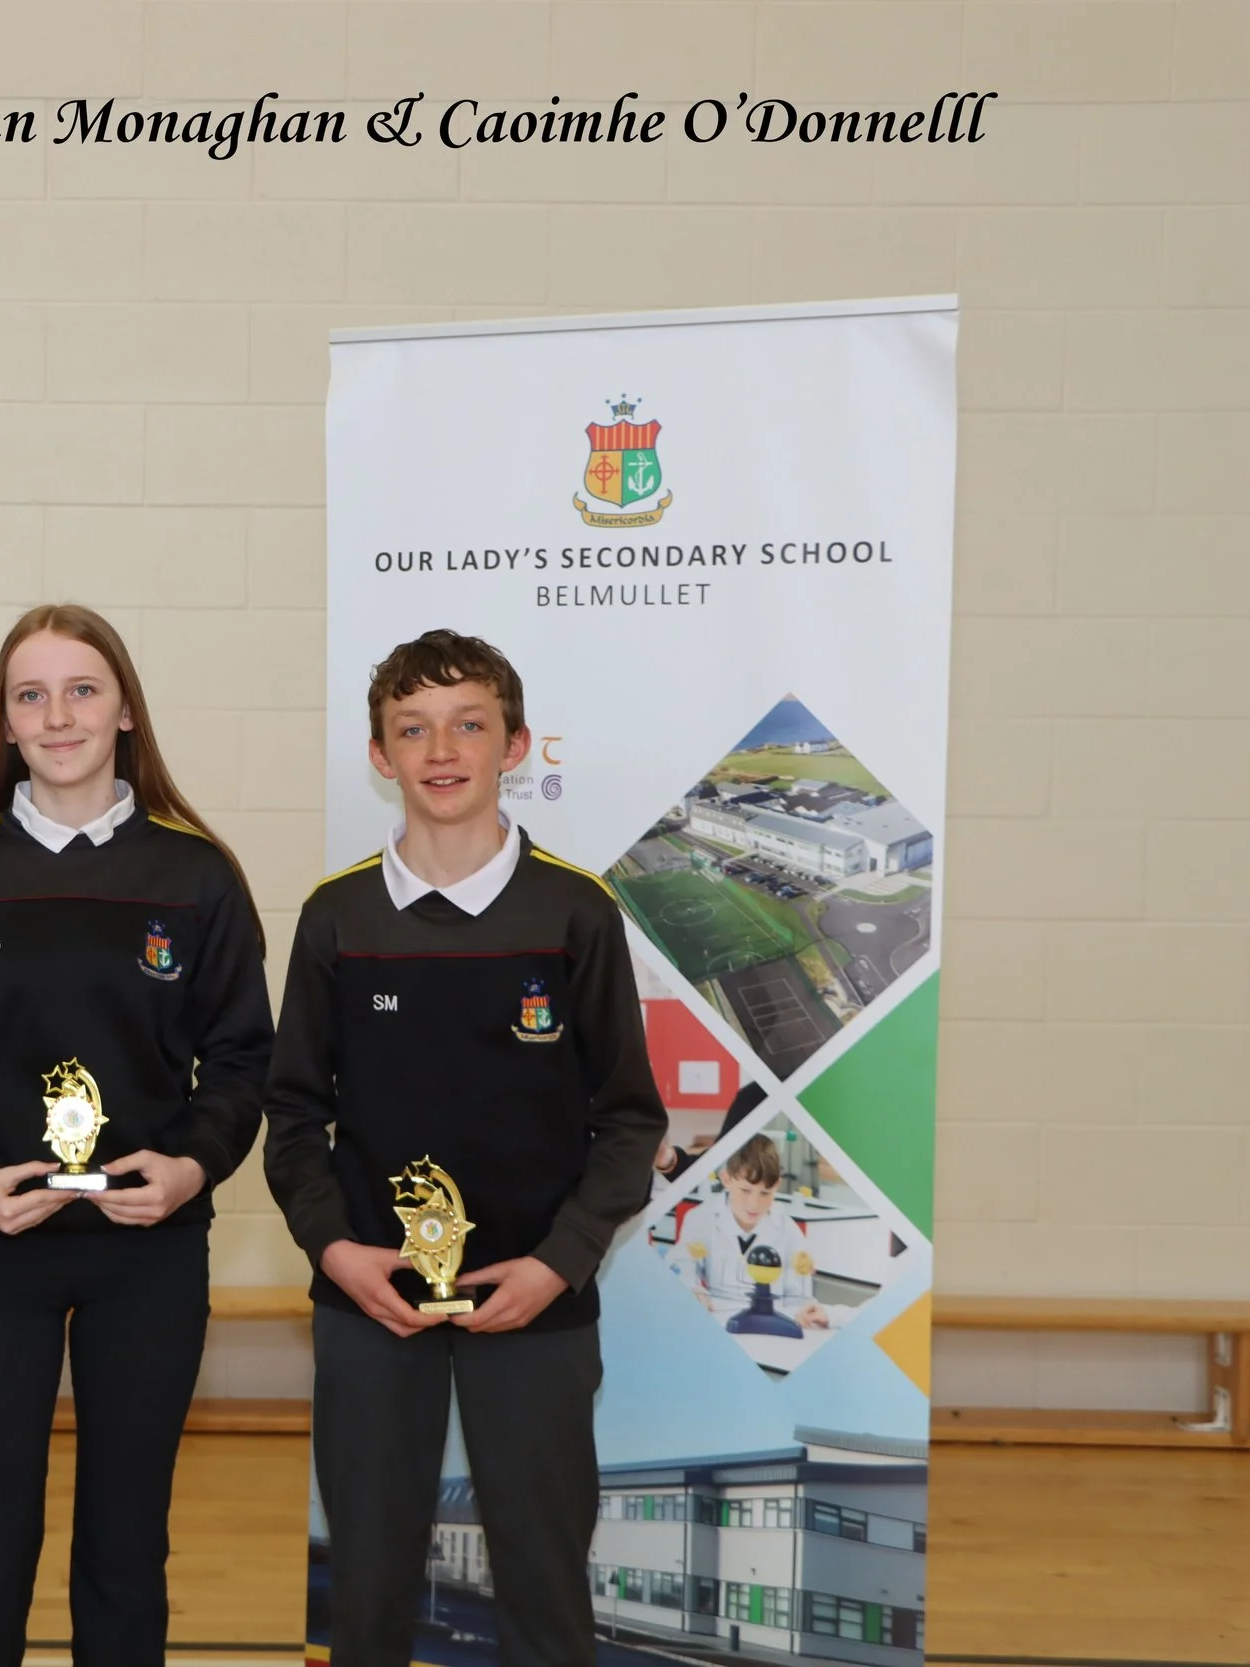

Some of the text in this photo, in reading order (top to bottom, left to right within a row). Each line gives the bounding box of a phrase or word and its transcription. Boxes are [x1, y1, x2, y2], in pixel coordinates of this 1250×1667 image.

[589, 514, 655, 526] Misericordia
[375, 540, 892, 573] OUR LADY’S SECONDARY SCHOOL
[536, 583, 711, 607] BELMULLET
[506, 788, 533, 800] Trust
[373, 994, 398, 1011] SM
